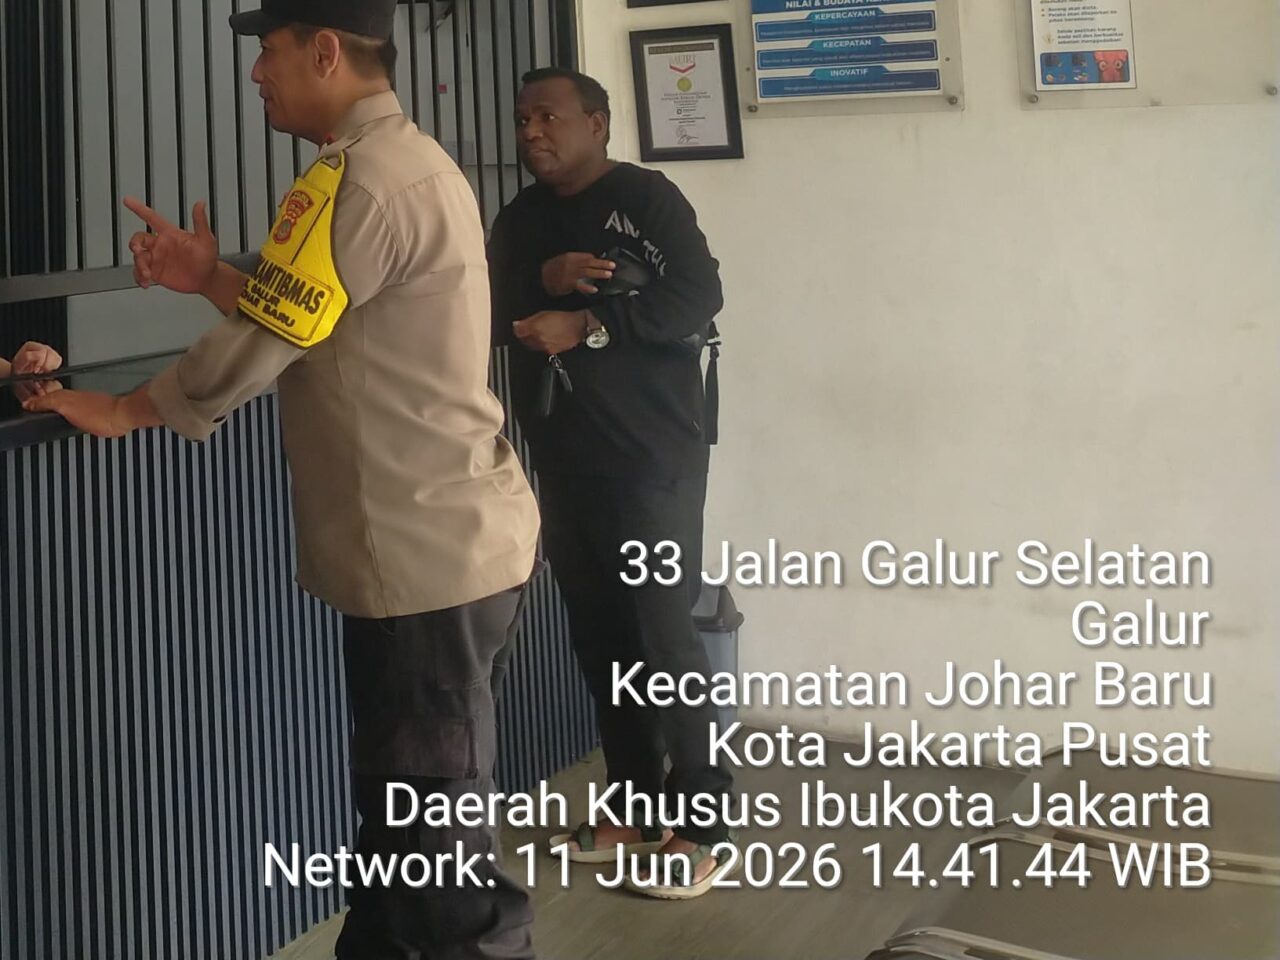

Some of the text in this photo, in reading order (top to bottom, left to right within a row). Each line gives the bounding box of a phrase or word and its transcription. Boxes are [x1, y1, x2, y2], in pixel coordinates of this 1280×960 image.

[785, 0, 812, 10] NILAI
[814, 9, 877, 21] KEPERCAYAAN
[822, 38, 872, 49] KECEPATAN
[830, 68, 869, 78] INOVATIF
[251, 283, 280, 307] GALUR
[262, 303, 296, 328] BARU
